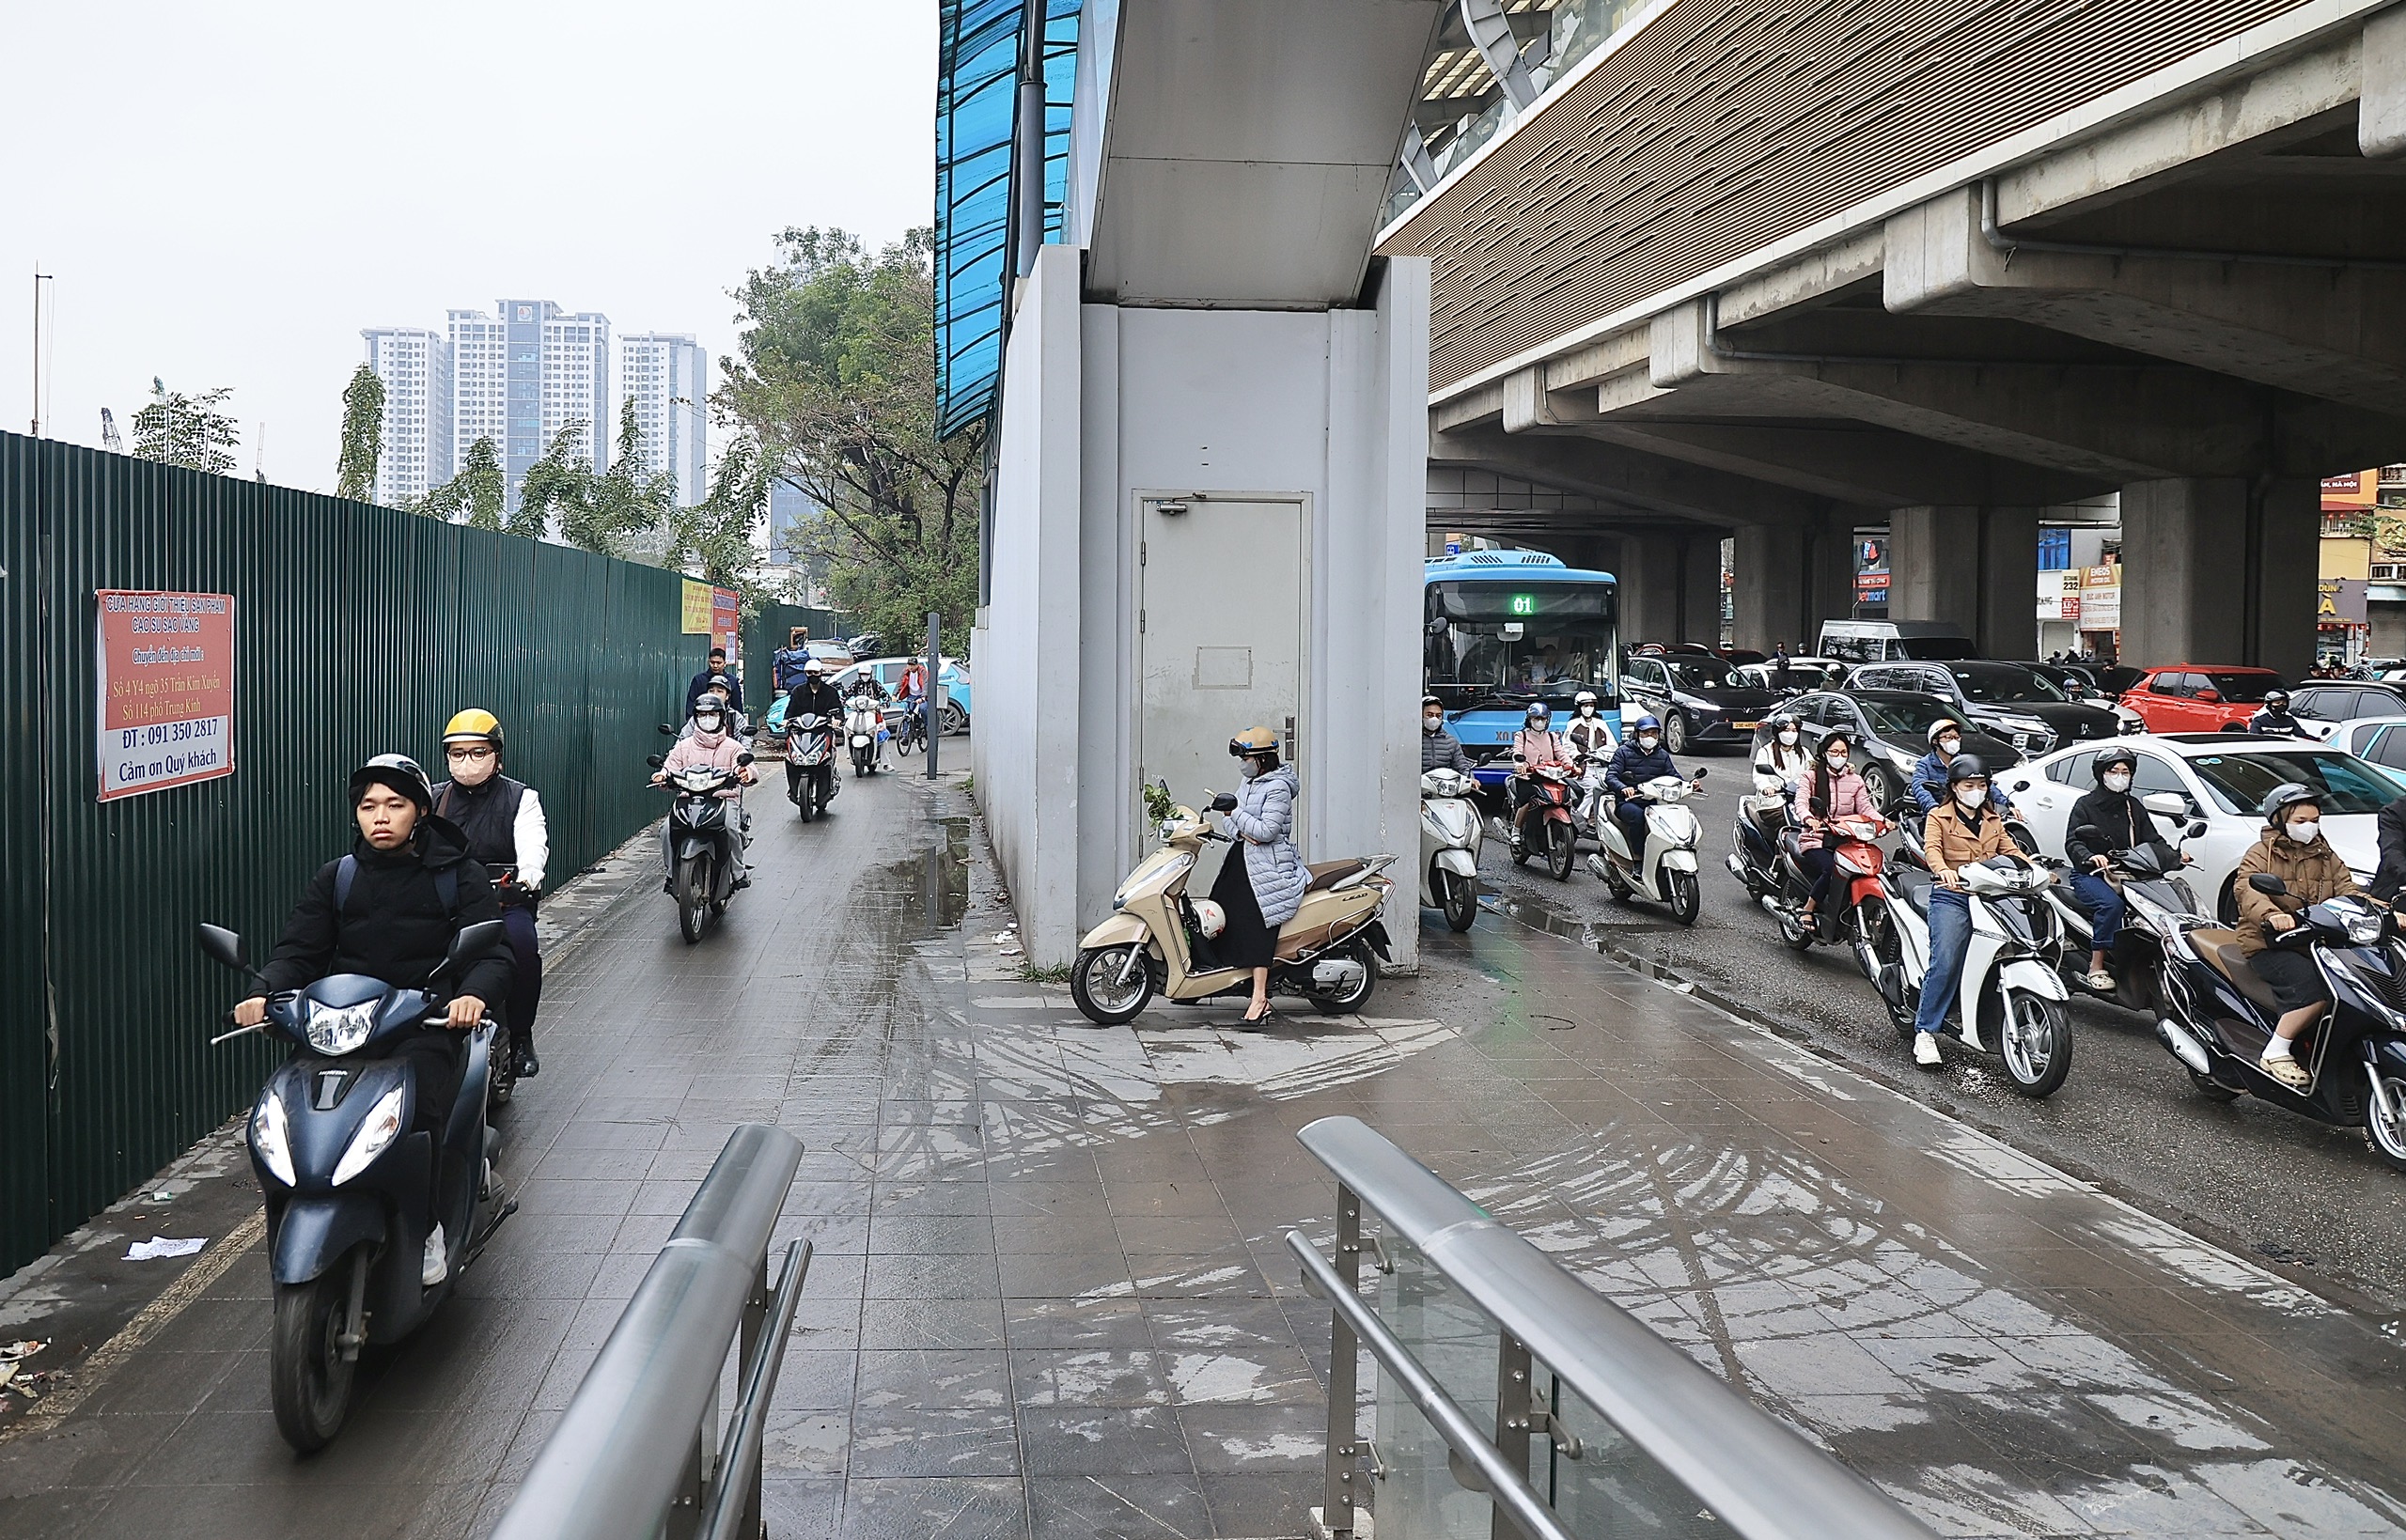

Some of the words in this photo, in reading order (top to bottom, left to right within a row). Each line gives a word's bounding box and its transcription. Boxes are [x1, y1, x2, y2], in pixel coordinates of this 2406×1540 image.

[2063, 582, 2078, 590] 232
[105, 592, 126, 612] CỬA
[127, 593, 150, 613] HÀNG
[152, 593, 168, 613] GIỚI
[169, 596, 190, 616] THIỆU
[1513, 597, 1533, 613] 01
[132, 616, 149, 633] CAO
[150, 616, 162, 633] SU
[162, 616, 179, 633] SAO
[179, 614, 199, 633] VÀNG
[113, 676, 124, 697] Số
[125, 680, 131, 696] 4
[133, 679, 143, 696] Y4
[160, 677, 168, 693] 35
[186, 675, 200, 691] Kim
[122, 699, 133, 721] Số
[135, 703, 148, 720] 114
[150, 696, 164, 722] phố
[164, 700, 184, 718] Trung
[185, 697, 201, 713] Kính
[122, 728, 138, 749] ĐT
[148, 724, 168, 745] 091
[172, 722, 192, 742] 350
[194, 719, 218, 739] 2817
[119, 761, 146, 782] Cảm
[148, 761, 163, 777] ơn
[165, 753, 185, 775] Quý
[188, 748, 217, 769] khách
[1342, 893, 1368, 902] LEAD
